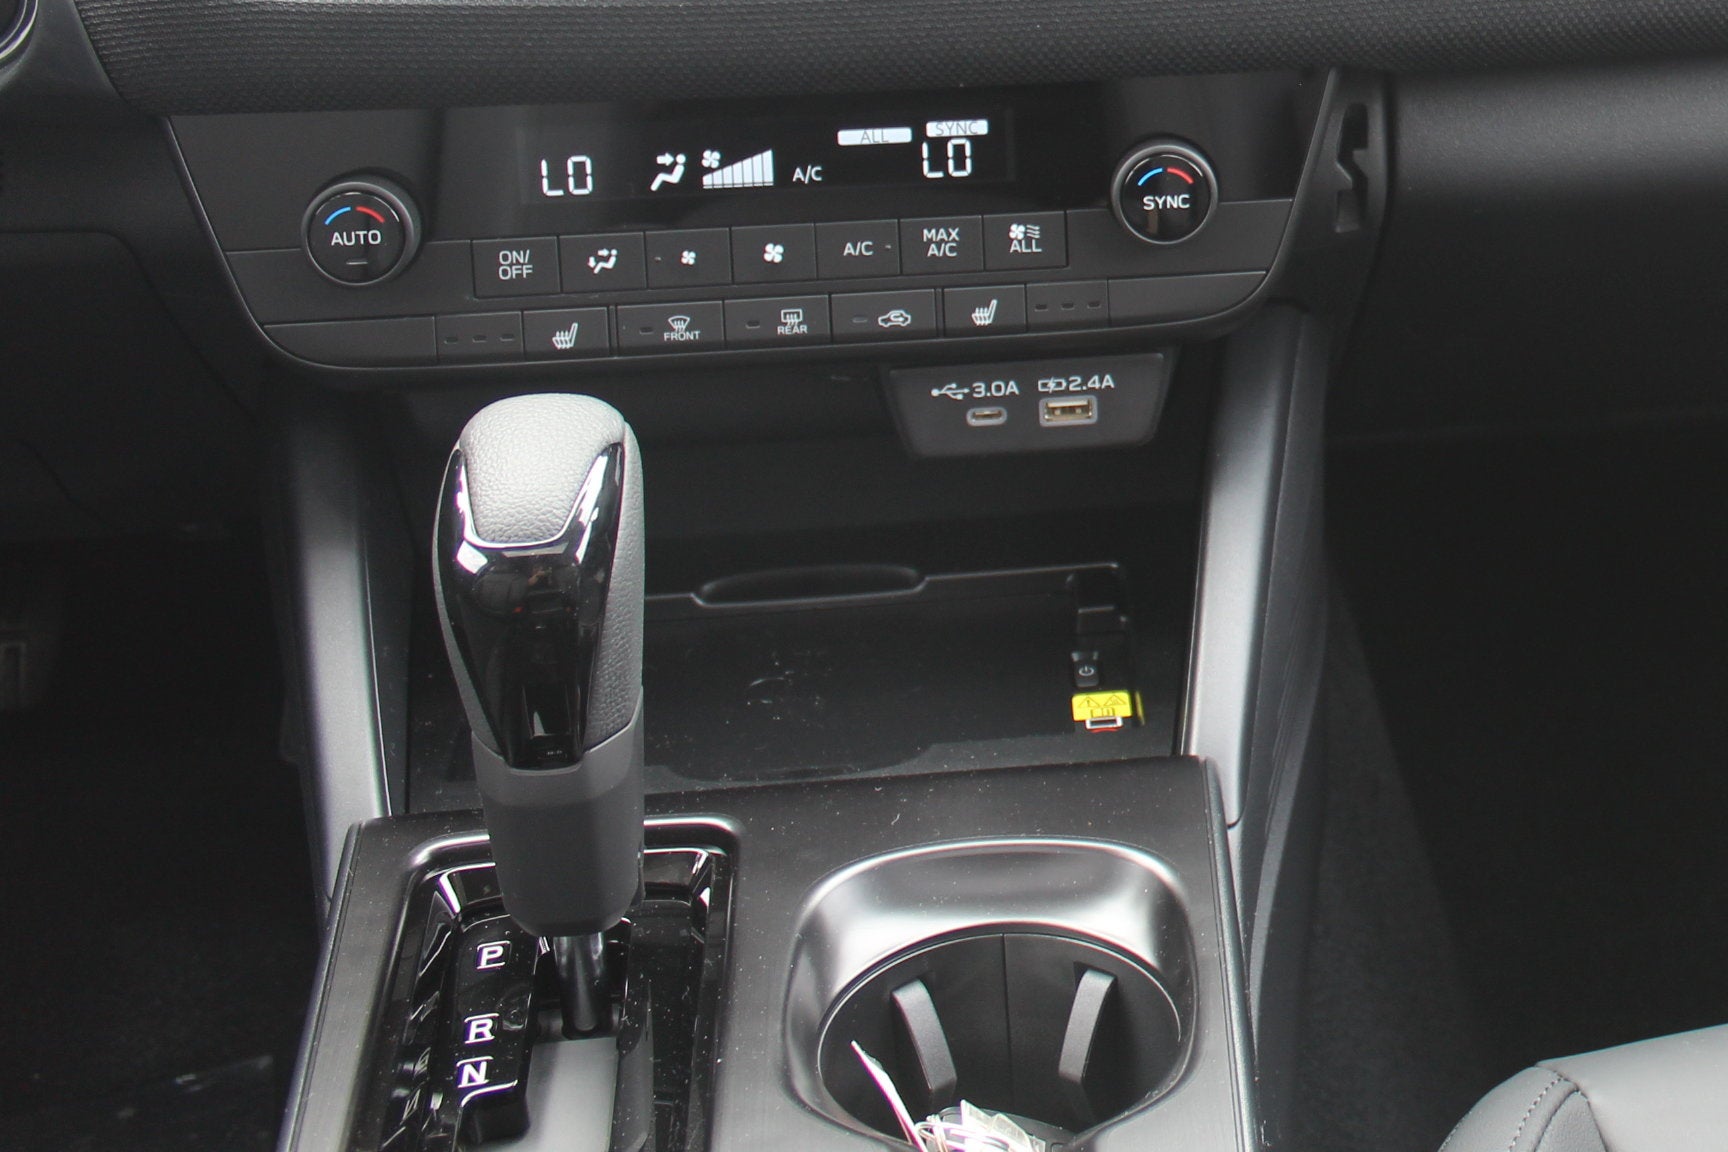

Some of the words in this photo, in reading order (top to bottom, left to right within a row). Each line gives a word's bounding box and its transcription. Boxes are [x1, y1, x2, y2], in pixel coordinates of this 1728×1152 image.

[922, 138, 972, 178] LO
[541, 155, 593, 196] LO
[792, 166, 823, 183] A/C
[1142, 194, 1190, 211] SYNC
[330, 229, 381, 246] AUTO
[923, 228, 959, 242] MAX
[843, 241, 873, 257] A/C
[927, 242, 958, 257] A/C
[1009, 238, 1042, 253] ALL
[499, 250, 530, 265] ON/
[498, 264, 533, 280] OFF
[663, 330, 700, 341] FRONT
[777, 325, 808, 335] REAR
[972, 381, 1019, 397] 3.0A
[1068, 375, 1115, 391] 2.4A
[480, 946, 503, 965] P
[468, 1019, 493, 1039] R
[460, 1062, 487, 1083] N
